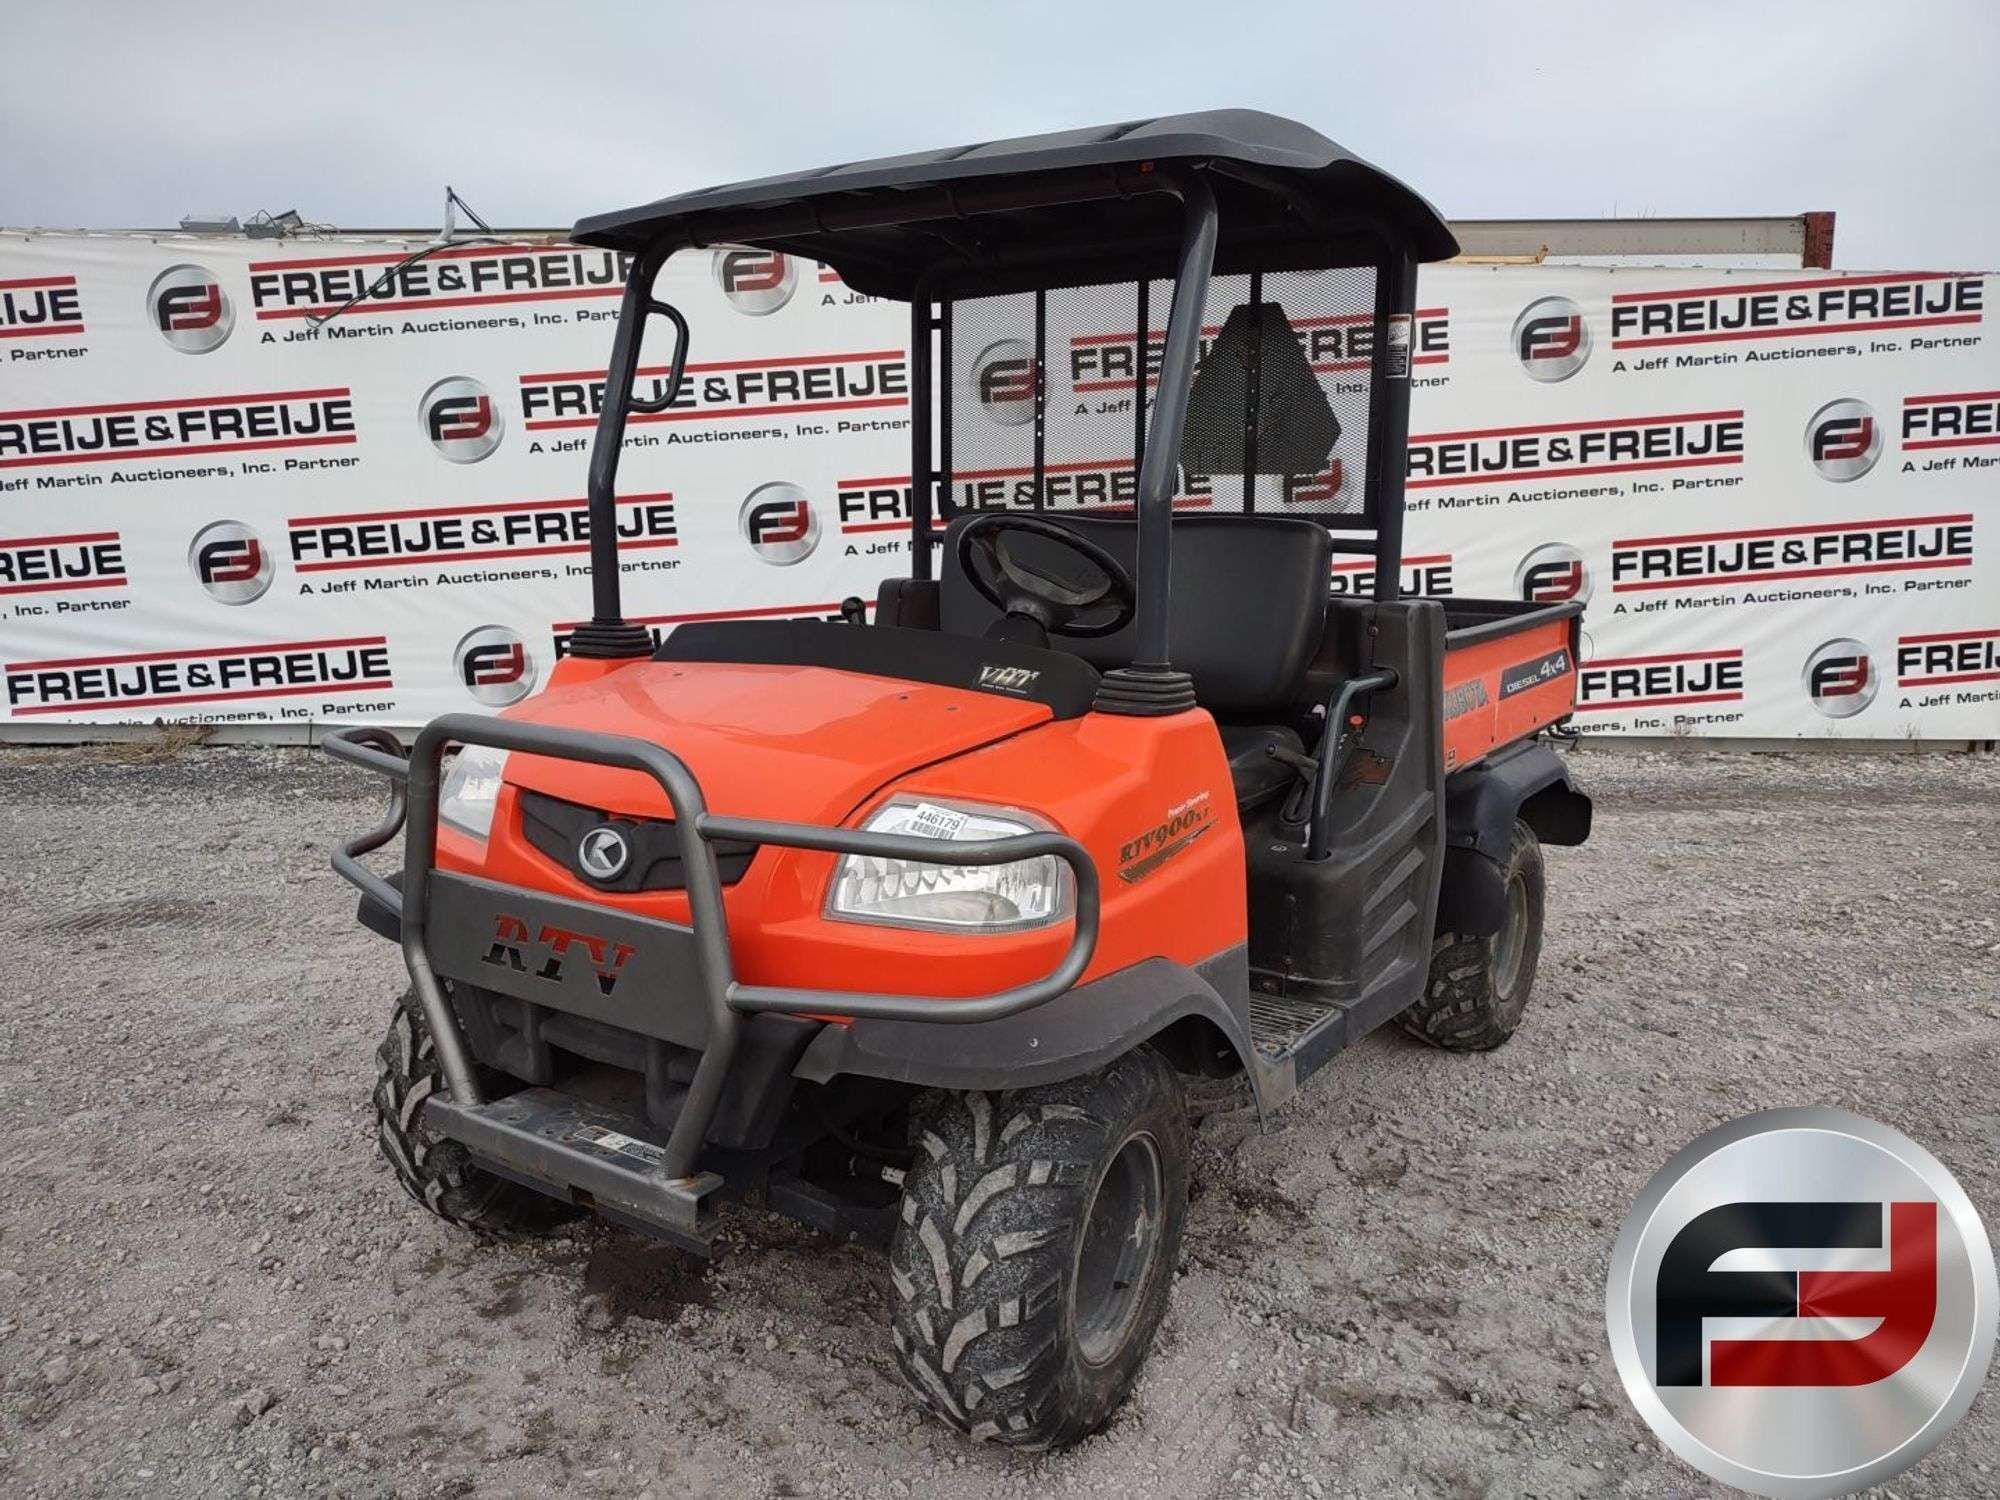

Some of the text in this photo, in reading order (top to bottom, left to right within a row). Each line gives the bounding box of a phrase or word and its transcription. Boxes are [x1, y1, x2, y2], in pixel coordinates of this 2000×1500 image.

[0, 289, 83, 326] IJE
[821, 294, 836, 306] A
[261, 331, 277, 344] A
[284, 327, 320, 342] Jeff
[328, 324, 393, 341] Martin
[401, 316, 527, 335] Auctioneers,
[534, 311, 568, 325] Inc.
[11, 345, 89, 363] Partner
[1612, 335, 1983, 373] A Jeff Martin Auctioneers, Inc. Partner
[529, 441, 544, 455] A
[551, 437, 588, 452] Jeff
[667, 424, 789, 446] Auctioneers,
[796, 421, 830, 437] Inc.
[837, 418, 912, 434] Partner
[37, 472, 103, 490] Martin
[111, 463, 235, 485] Auctioneers,
[243, 460, 278, 475] Inc.
[285, 455, 361, 473] Partner
[1902, 461, 1916, 473] A
[1922, 457, 1957, 471] Jeff
[1438, 493, 1500, 511] Martin
[1508, 484, 1626, 505] Auctioneers,
[1633, 480, 1666, 495] Inc.
[1672, 475, 1744, 492] Partner
[845, 544, 859, 556] A
[866, 540, 901, 555] Jeff
[300, 582, 314, 595] A
[321, 579, 357, 594] Jeff
[364, 573, 429, 591] Martin
[436, 566, 558, 586] Auctioneers,
[15, 597, 132, 618] Inc. Partner
[1613, 578, 1972, 614] A Jeff Martin Auctioneers, Inc. Partner
[1898, 641, 2000, 676] FREI
[281, 705, 315, 719] Inc.
[323, 701, 397, 716] Partner
[1900, 697, 1913, 709] A
[1919, 694, 1951, 708] Jeff
[1634, 717, 1667, 729] Inc.
[1673, 712, 1745, 726] Partner
[916, 808, 961, 832] 446179
[480, 912, 638, 998] RTV
